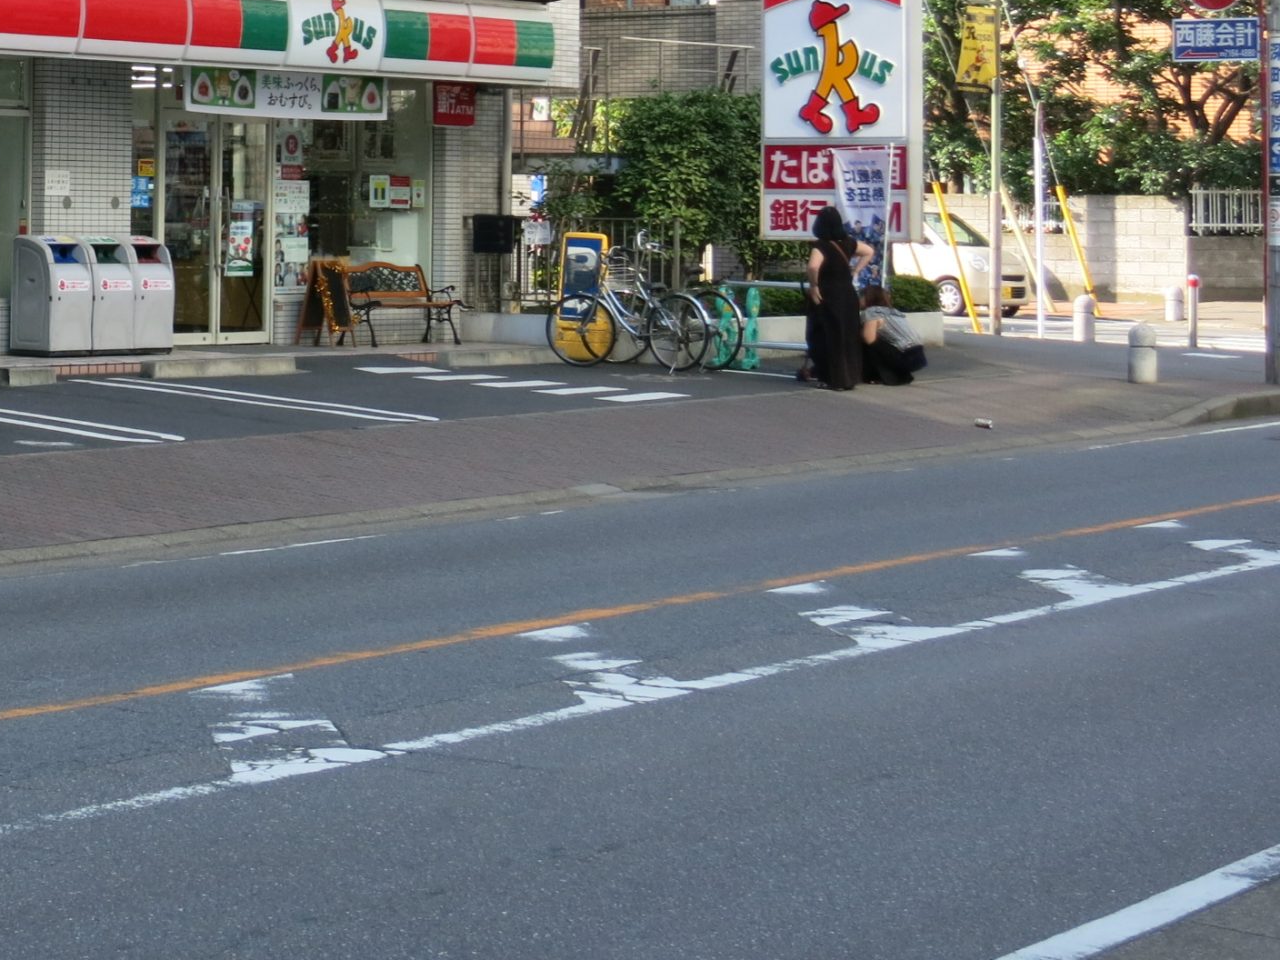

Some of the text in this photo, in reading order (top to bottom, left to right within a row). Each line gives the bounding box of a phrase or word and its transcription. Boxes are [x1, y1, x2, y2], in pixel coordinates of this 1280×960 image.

[1176, 22, 1256, 47] 西藤会計
[770, 150, 831, 183] たば
[769, 199, 828, 231] 銀行
